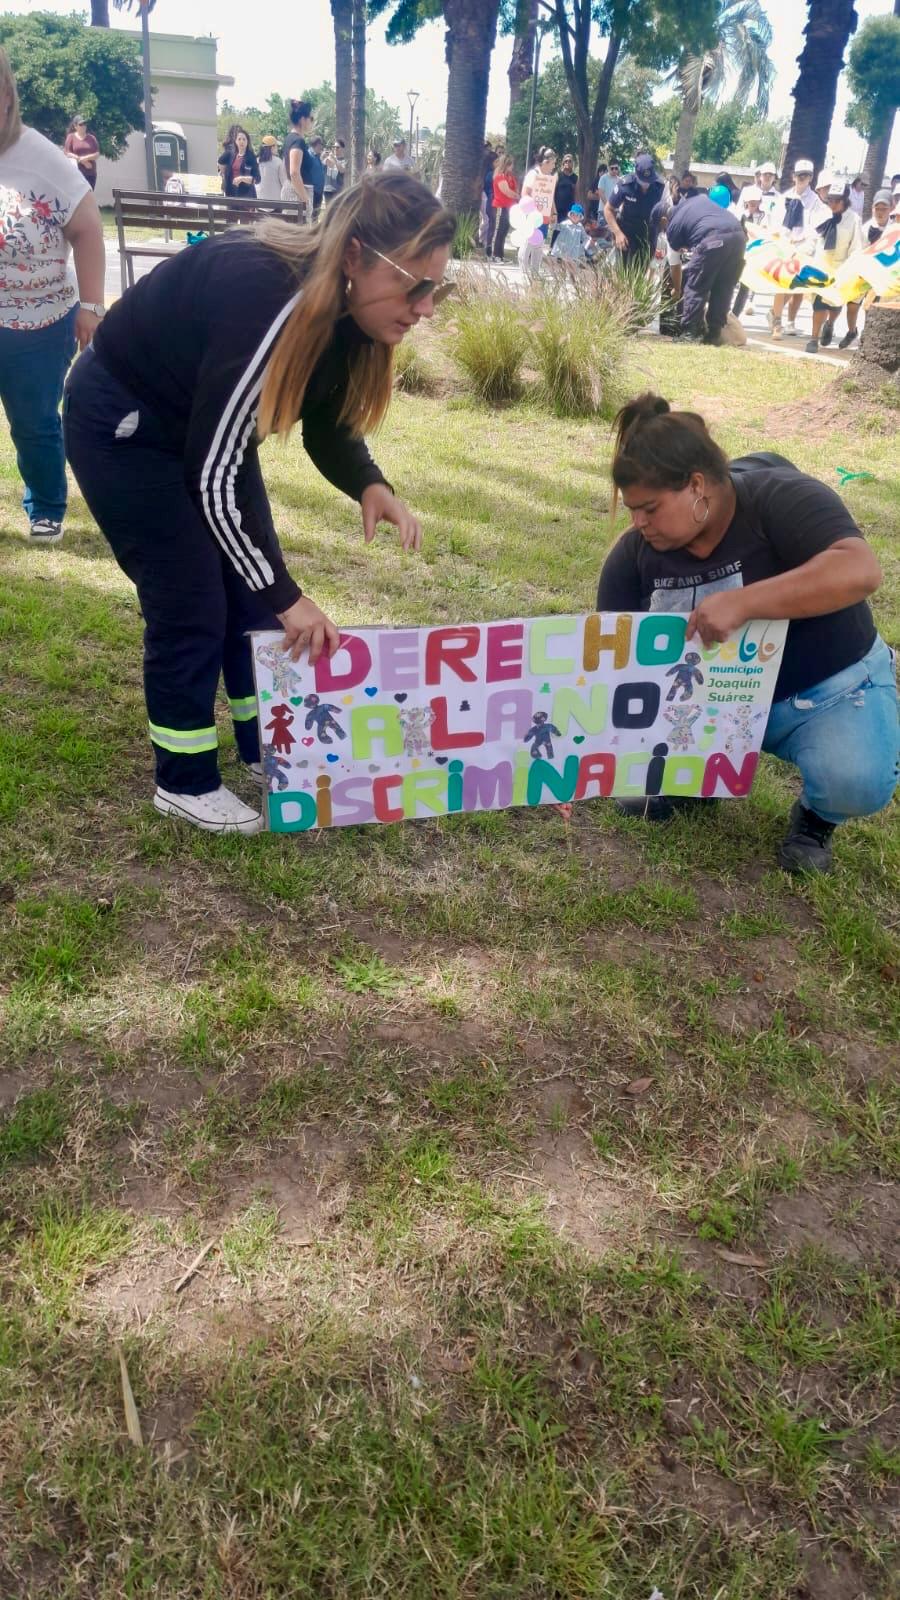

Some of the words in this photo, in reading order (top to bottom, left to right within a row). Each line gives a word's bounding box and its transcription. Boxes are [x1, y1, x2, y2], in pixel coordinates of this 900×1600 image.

[677, 574, 703, 588] AND
[707, 560, 743, 581] SURF
[314, 613, 688, 693] DERECHO
[708, 665, 764, 677] municipio
[707, 677, 761, 690] Joaquín
[707, 691, 754, 703] Suárez
[351, 704, 405, 760] A
[430, 688, 534, 751] LA
[551, 681, 661, 740] NO
